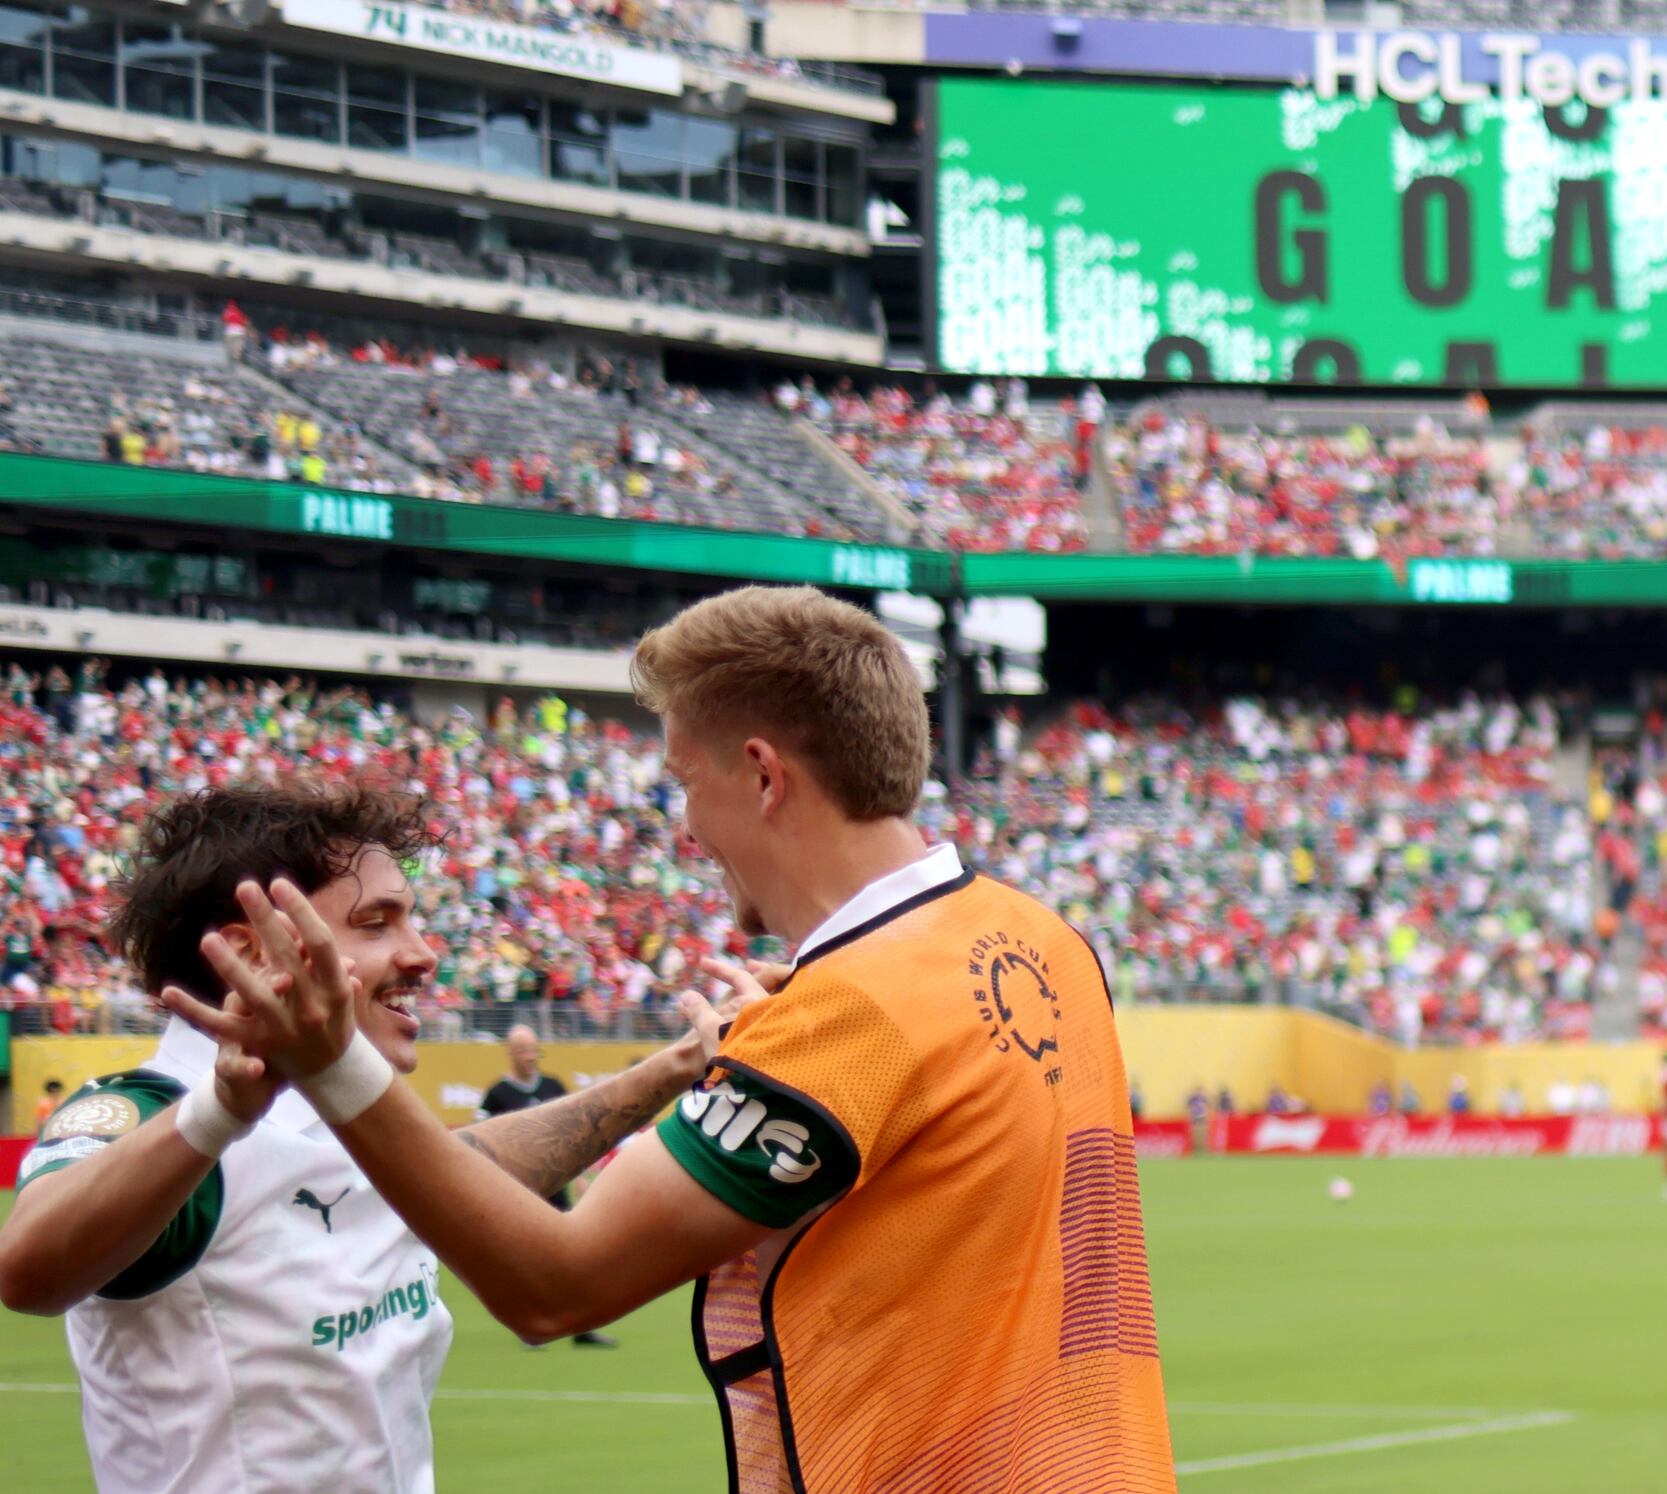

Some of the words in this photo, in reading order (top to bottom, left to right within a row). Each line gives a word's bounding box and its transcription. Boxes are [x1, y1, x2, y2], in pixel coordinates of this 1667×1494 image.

[363, 5, 408, 39] 74
[421, 18, 482, 47] NICK
[485, 31, 615, 74] MANGOLD
[968, 931, 1009, 977] WORLD
